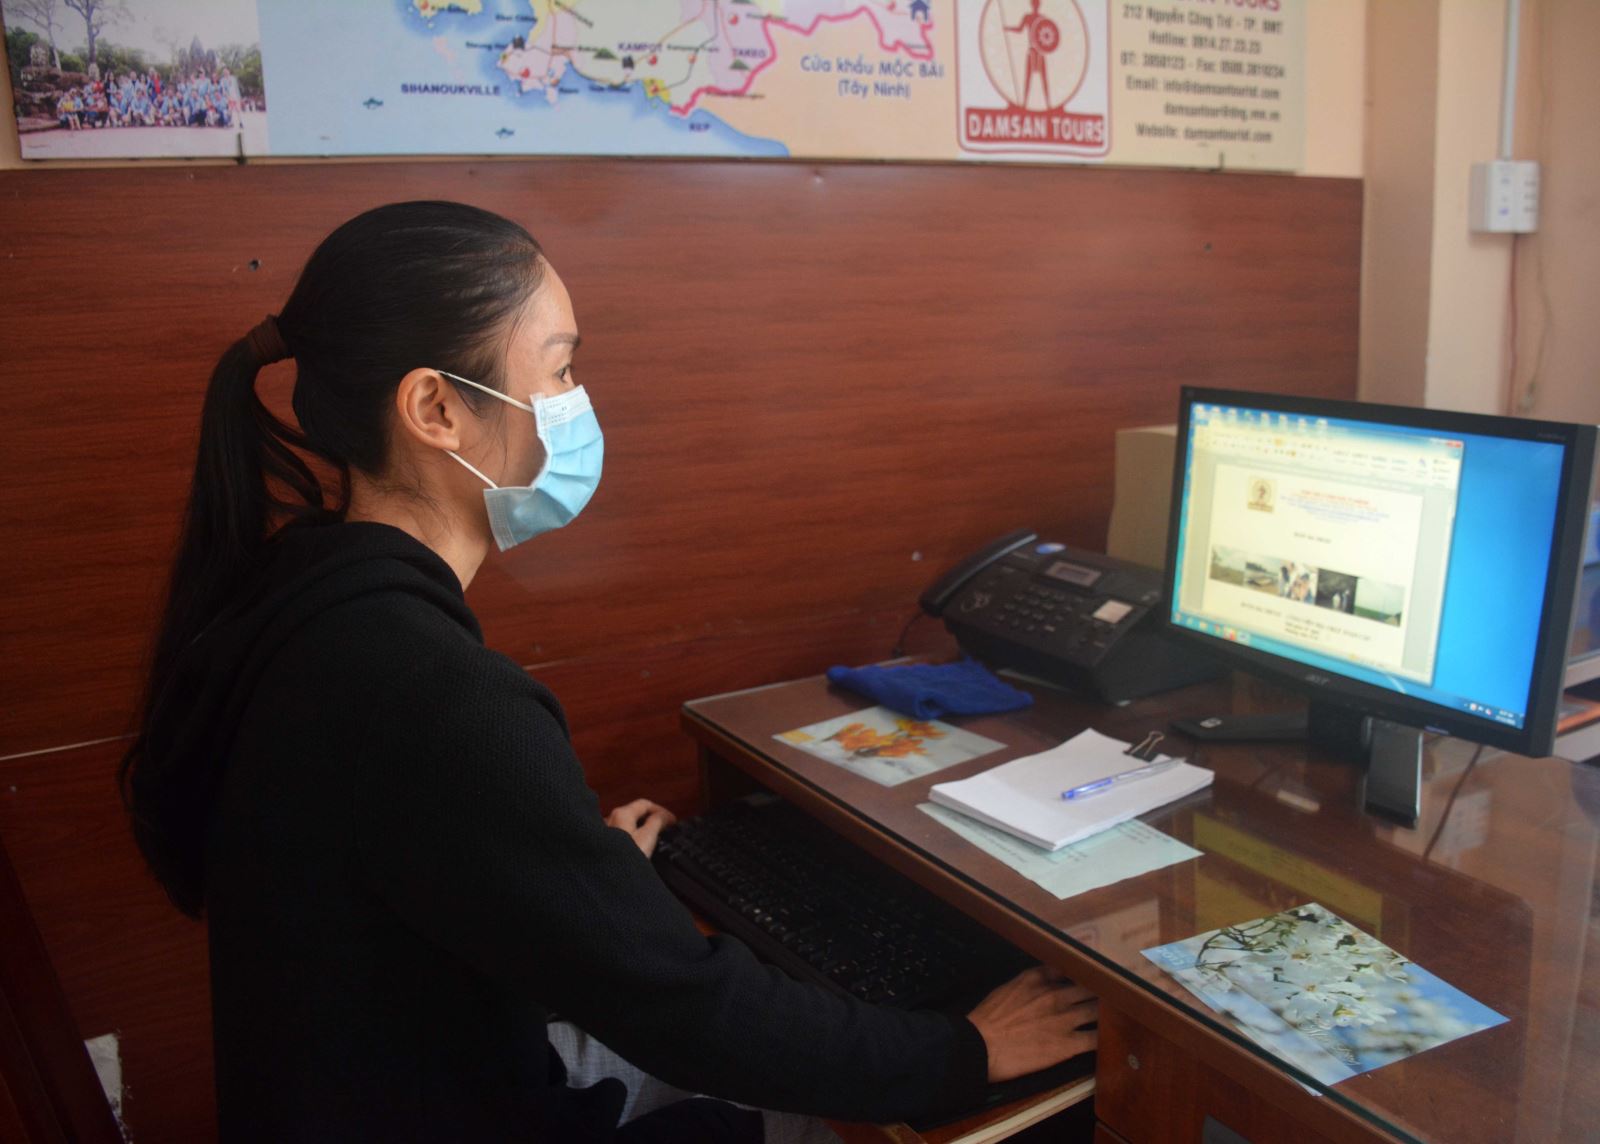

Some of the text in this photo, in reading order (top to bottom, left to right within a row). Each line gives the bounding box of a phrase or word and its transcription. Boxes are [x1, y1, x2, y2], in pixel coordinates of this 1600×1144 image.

[401, 83, 501, 95] SIHANOUKVILLE
[968, 114, 1104, 142] DAMSAN TOURS
